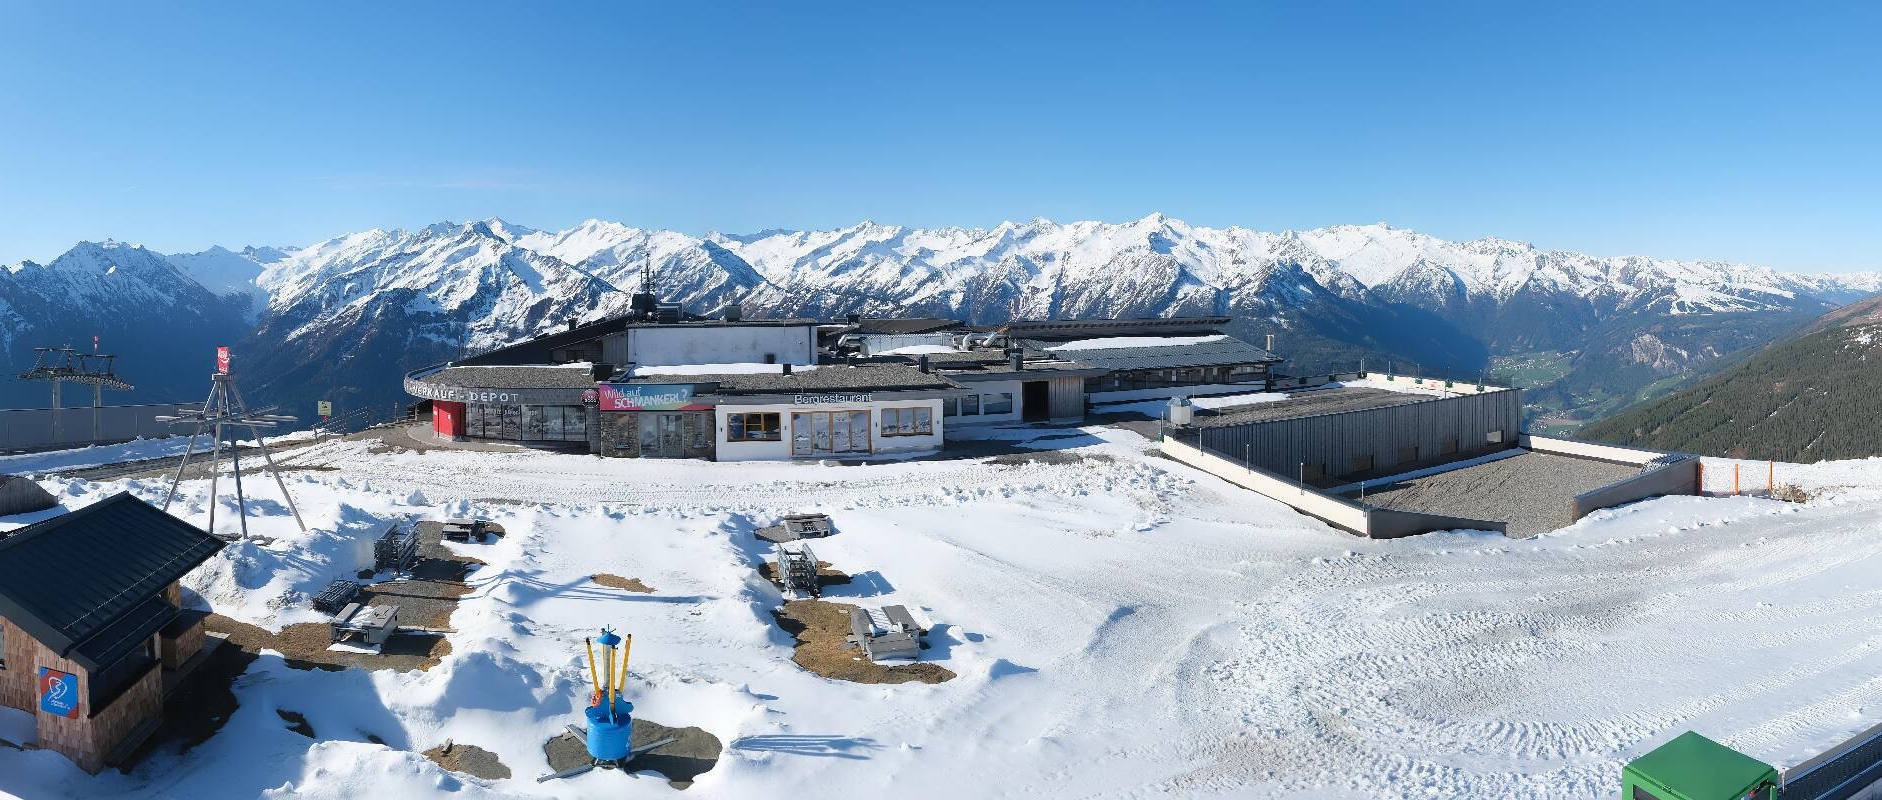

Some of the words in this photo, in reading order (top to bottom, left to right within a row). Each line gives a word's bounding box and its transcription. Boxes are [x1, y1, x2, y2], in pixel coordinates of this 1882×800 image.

[413, 385, 454, 399] VERKAUF
[470, 391, 519, 402] DEPOT
[604, 388, 624, 399] Wild
[626, 386, 642, 397] auf
[794, 392, 872, 405] Bergrestaurant
